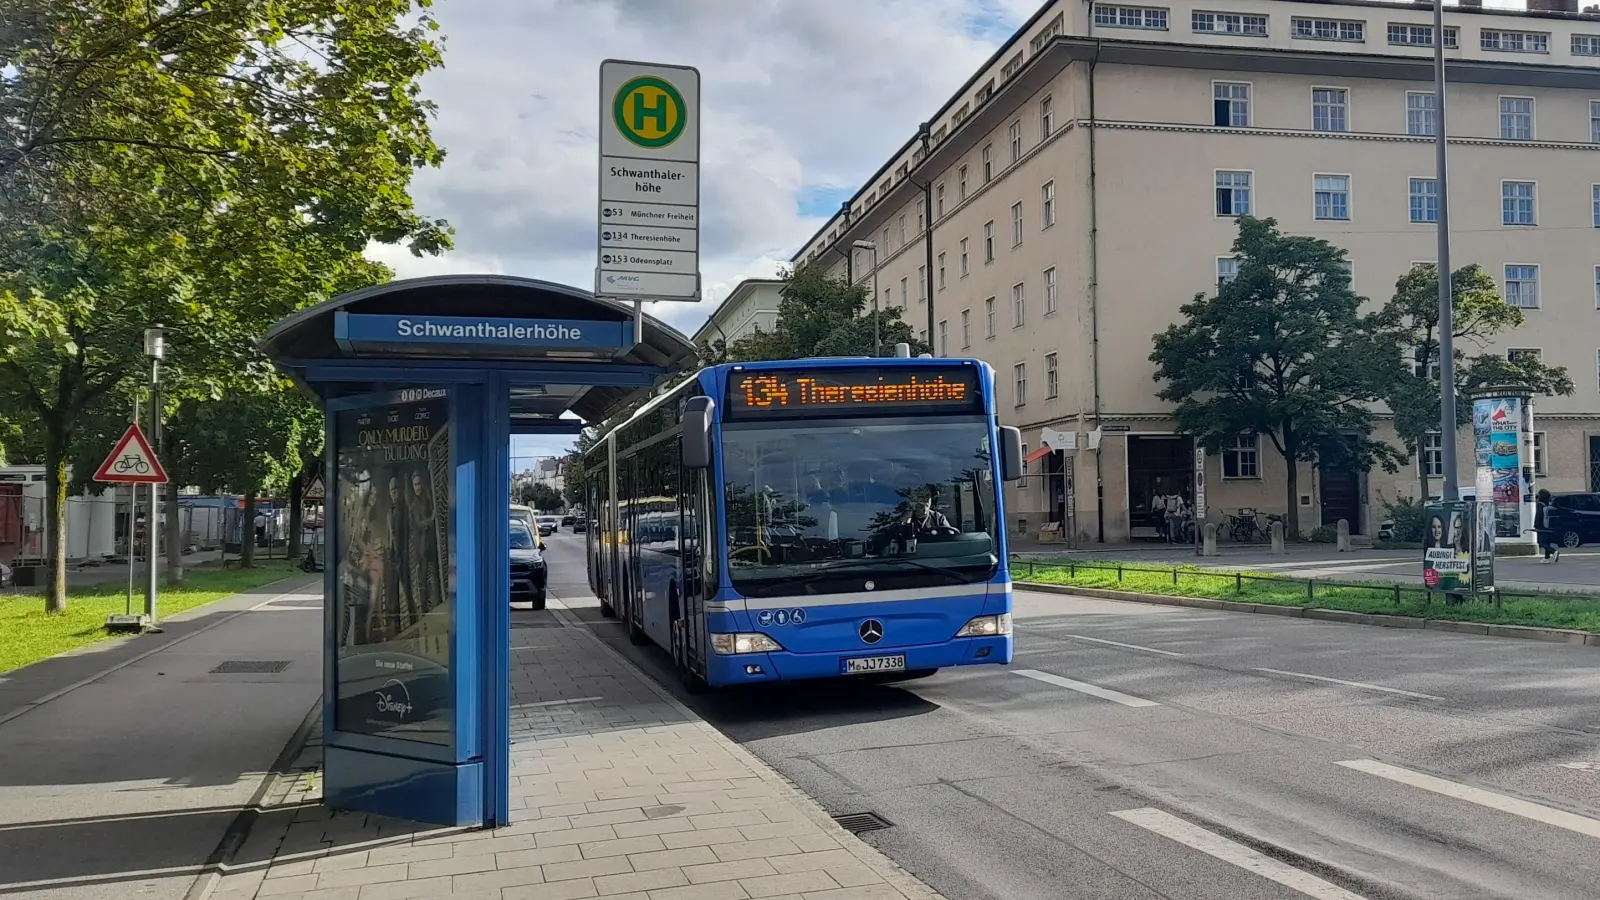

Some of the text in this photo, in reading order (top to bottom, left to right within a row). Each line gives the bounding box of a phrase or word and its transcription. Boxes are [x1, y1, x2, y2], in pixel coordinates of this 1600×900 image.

[633, 92, 667, 132] H
[610, 166, 686, 181] Schwanthaler-
[635, 182, 662, 193] höhe
[612, 208, 623, 216] 53
[630, 210, 665, 219] Münchner
[667, 212, 694, 221] Freiheit
[612, 231, 628, 240] 134
[630, 233, 681, 243] Theresienhöhe
[612, 255, 628, 263] 153
[629, 256, 673, 266] Odeonsplatz
[397, 319, 582, 341] Schwanthalerhöhe
[739, 374, 967, 406] 134 Theresienhöhe
[358, 424, 429, 446] ONLY MURDERS
[383, 443, 427, 461] BUILDING
[396, 660, 413, 671] Staffel
